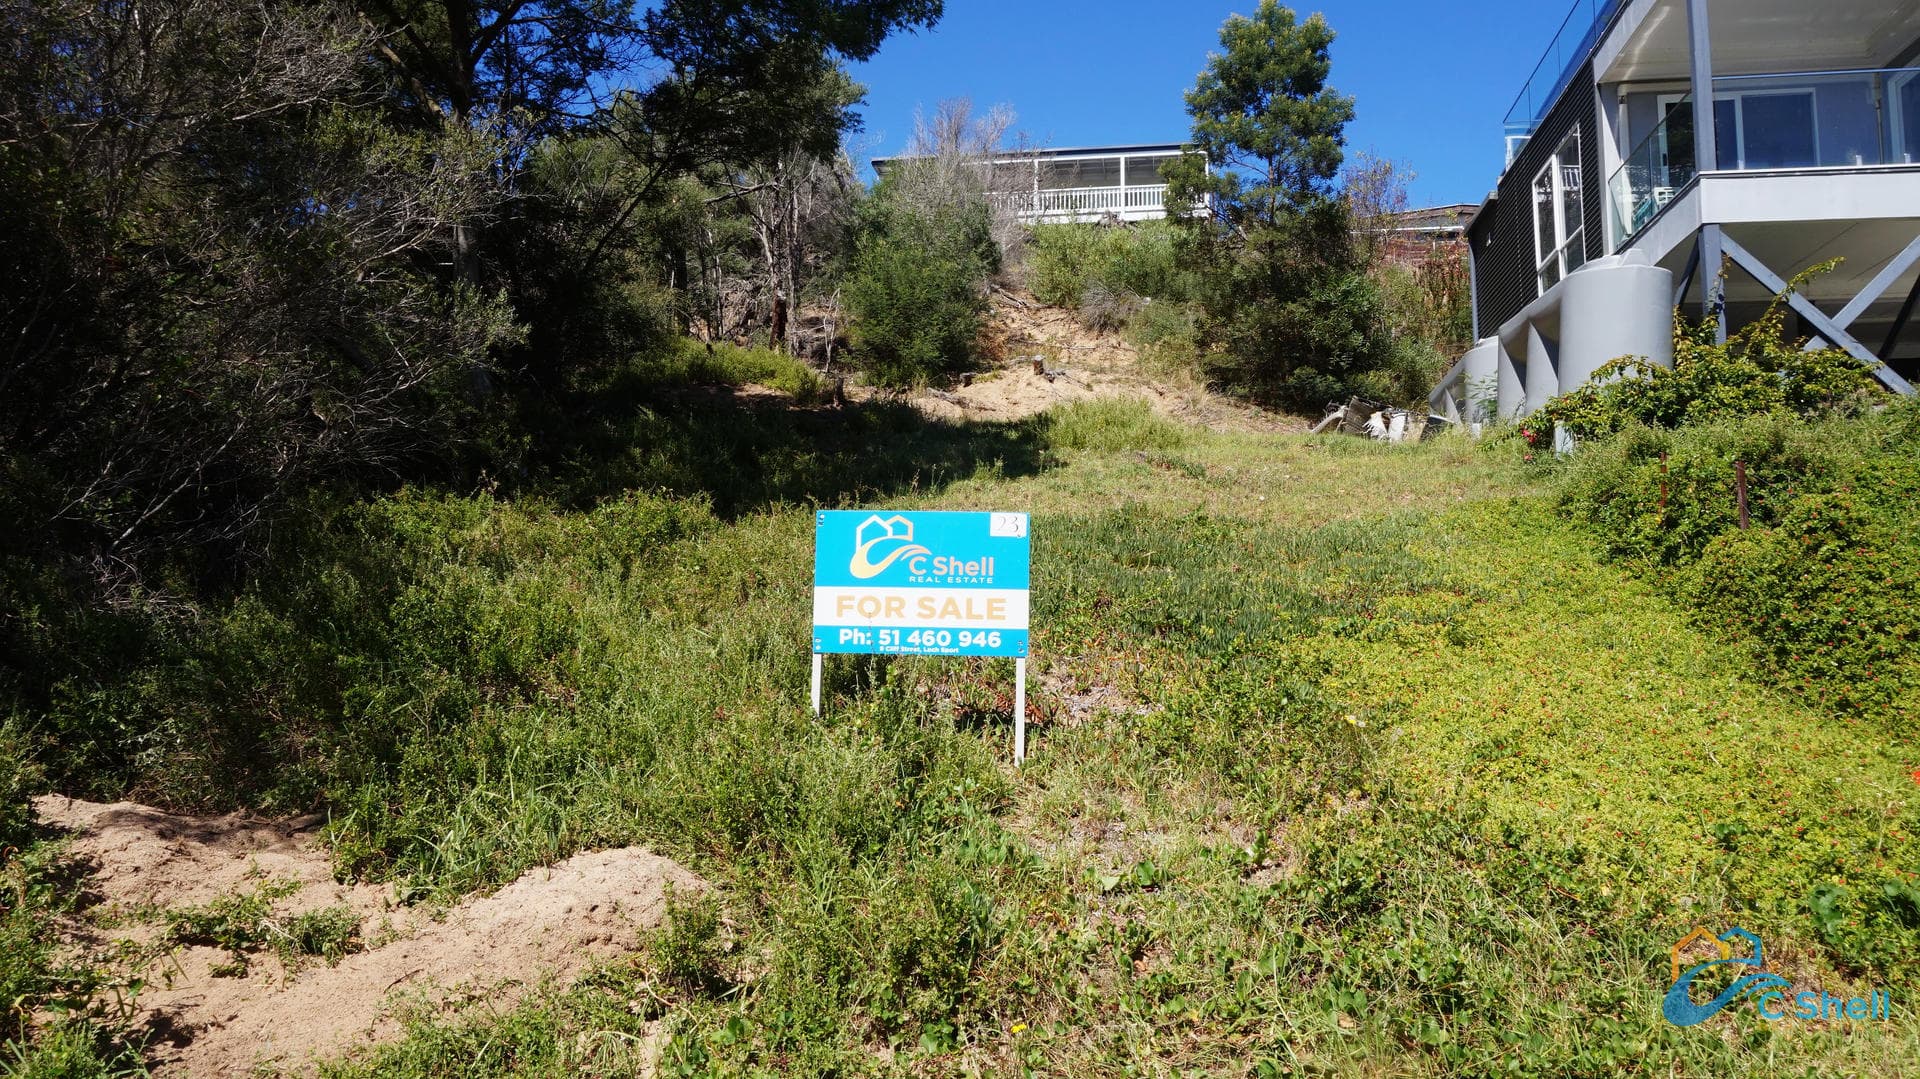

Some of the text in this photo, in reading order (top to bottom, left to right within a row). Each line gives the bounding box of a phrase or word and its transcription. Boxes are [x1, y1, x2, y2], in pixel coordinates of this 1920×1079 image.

[993, 515, 1019, 533] 23
[909, 556, 994, 576] C Shell
[947, 576, 993, 584] ESTATE
[836, 595, 1007, 620] FOR SALE
[839, 628, 1001, 648] Ph: 51 460 946
